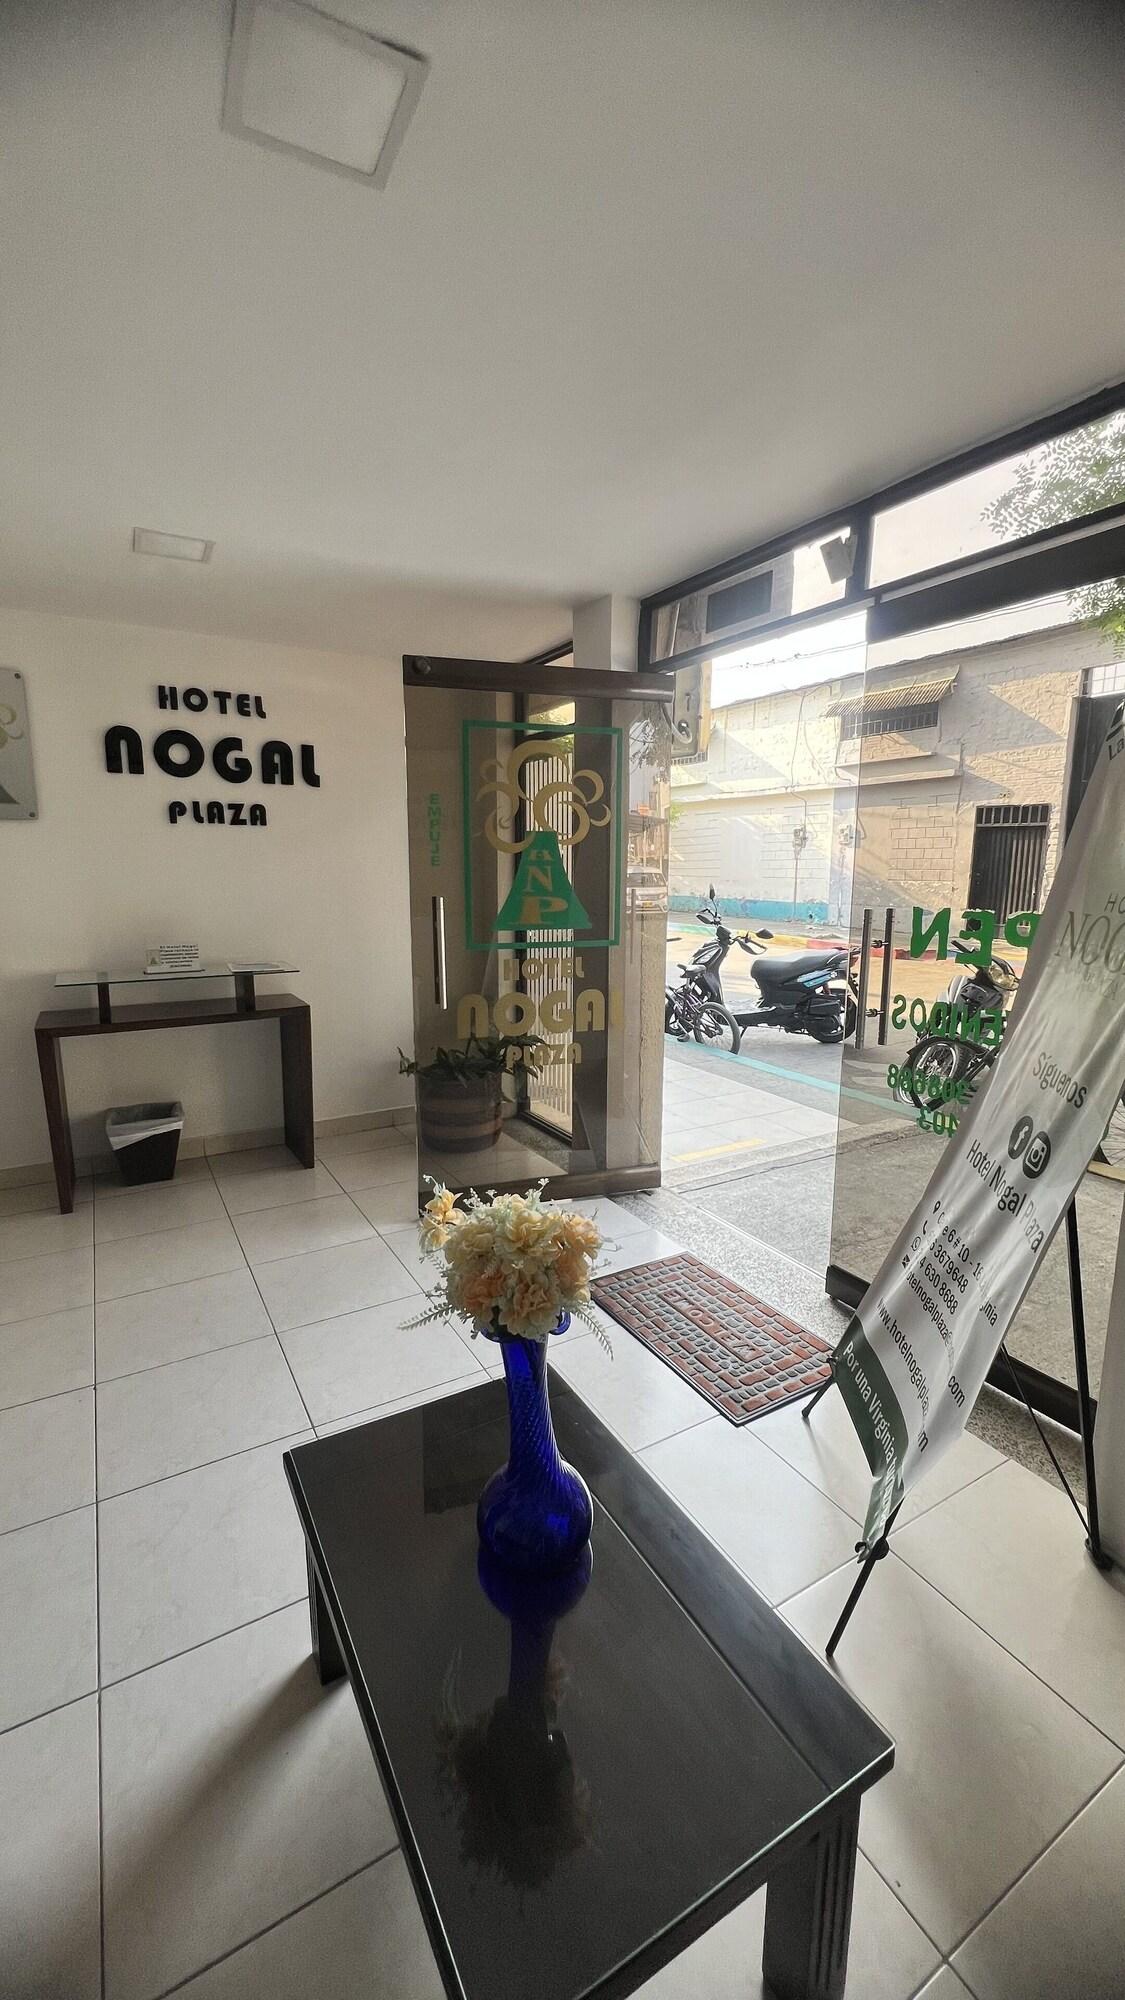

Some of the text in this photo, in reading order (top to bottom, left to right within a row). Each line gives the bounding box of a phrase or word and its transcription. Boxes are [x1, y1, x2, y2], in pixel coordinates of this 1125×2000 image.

[158, 685, 267, 719] HOTEL
[104, 725, 321, 788] NOGAL
[168, 801, 268, 826] PLAZA
[427, 793, 442, 867] EMPUJE
[503, 956, 585, 981] HOTEL
[506, 1043, 582, 1069] PLAZA
[1033, 1052, 1087, 1109] Síguenos
[966, 1139, 1045, 1253] Hotel Nogal Plaza
[924, 1263, 941, 1288] 630
[938, 1282, 959, 1315] 8688
[662, 1288, 757, 1359] WELCOME
[843, 1341, 860, 1372] Por
[854, 1369, 873, 1402] una
[868, 1393, 896, 1463] Virginia
